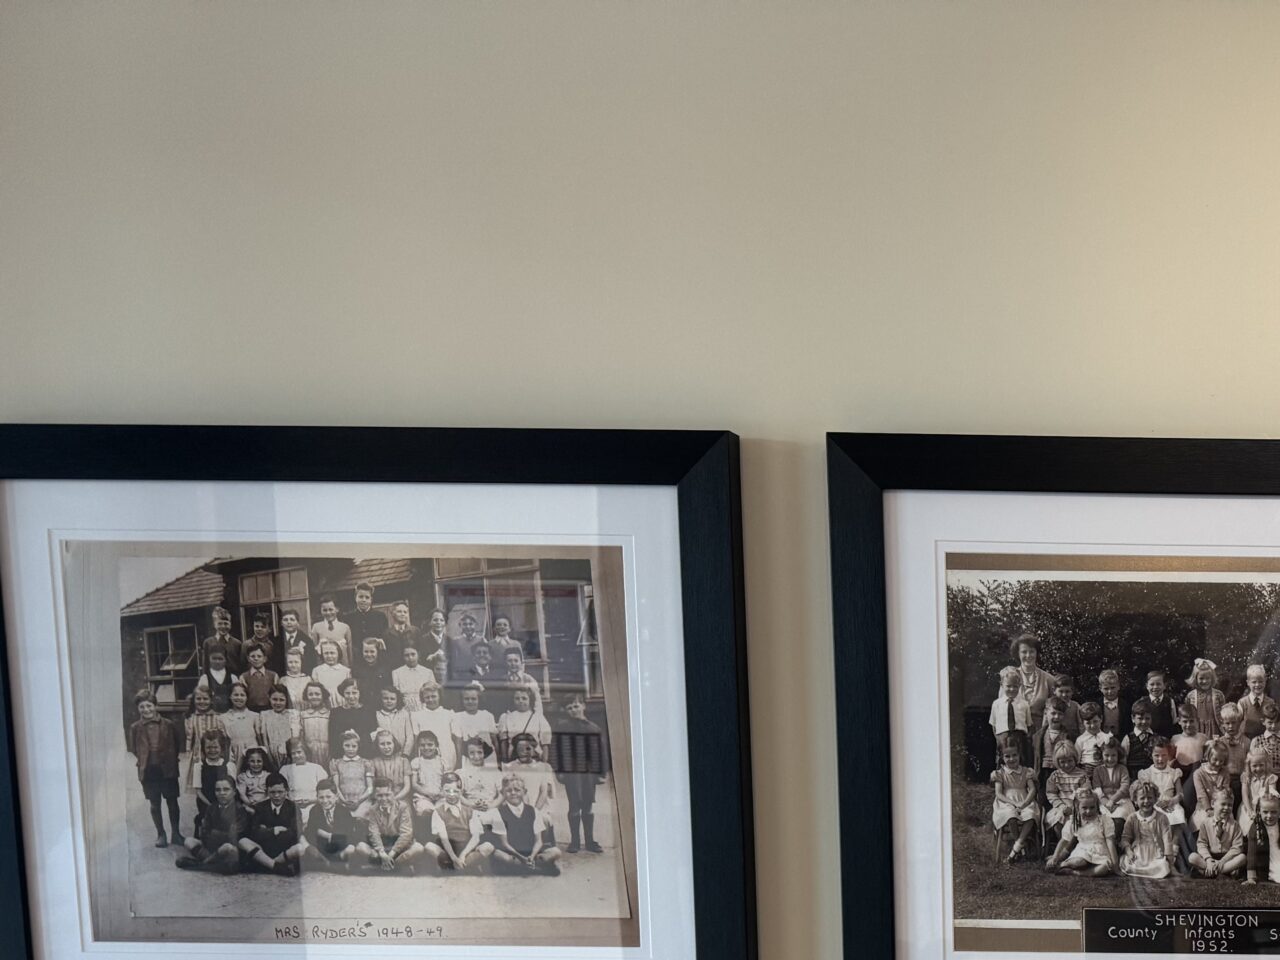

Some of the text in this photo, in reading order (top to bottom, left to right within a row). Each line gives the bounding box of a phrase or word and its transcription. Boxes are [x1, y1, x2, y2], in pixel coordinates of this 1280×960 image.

[1155, 914, 1259, 927] SHEVINGTON
[275, 925, 300, 940] MRS
[1108, 926, 1158, 940] County
[1185, 927, 1235, 939] Infants
[1192, 941, 1233, 952] 1952.
